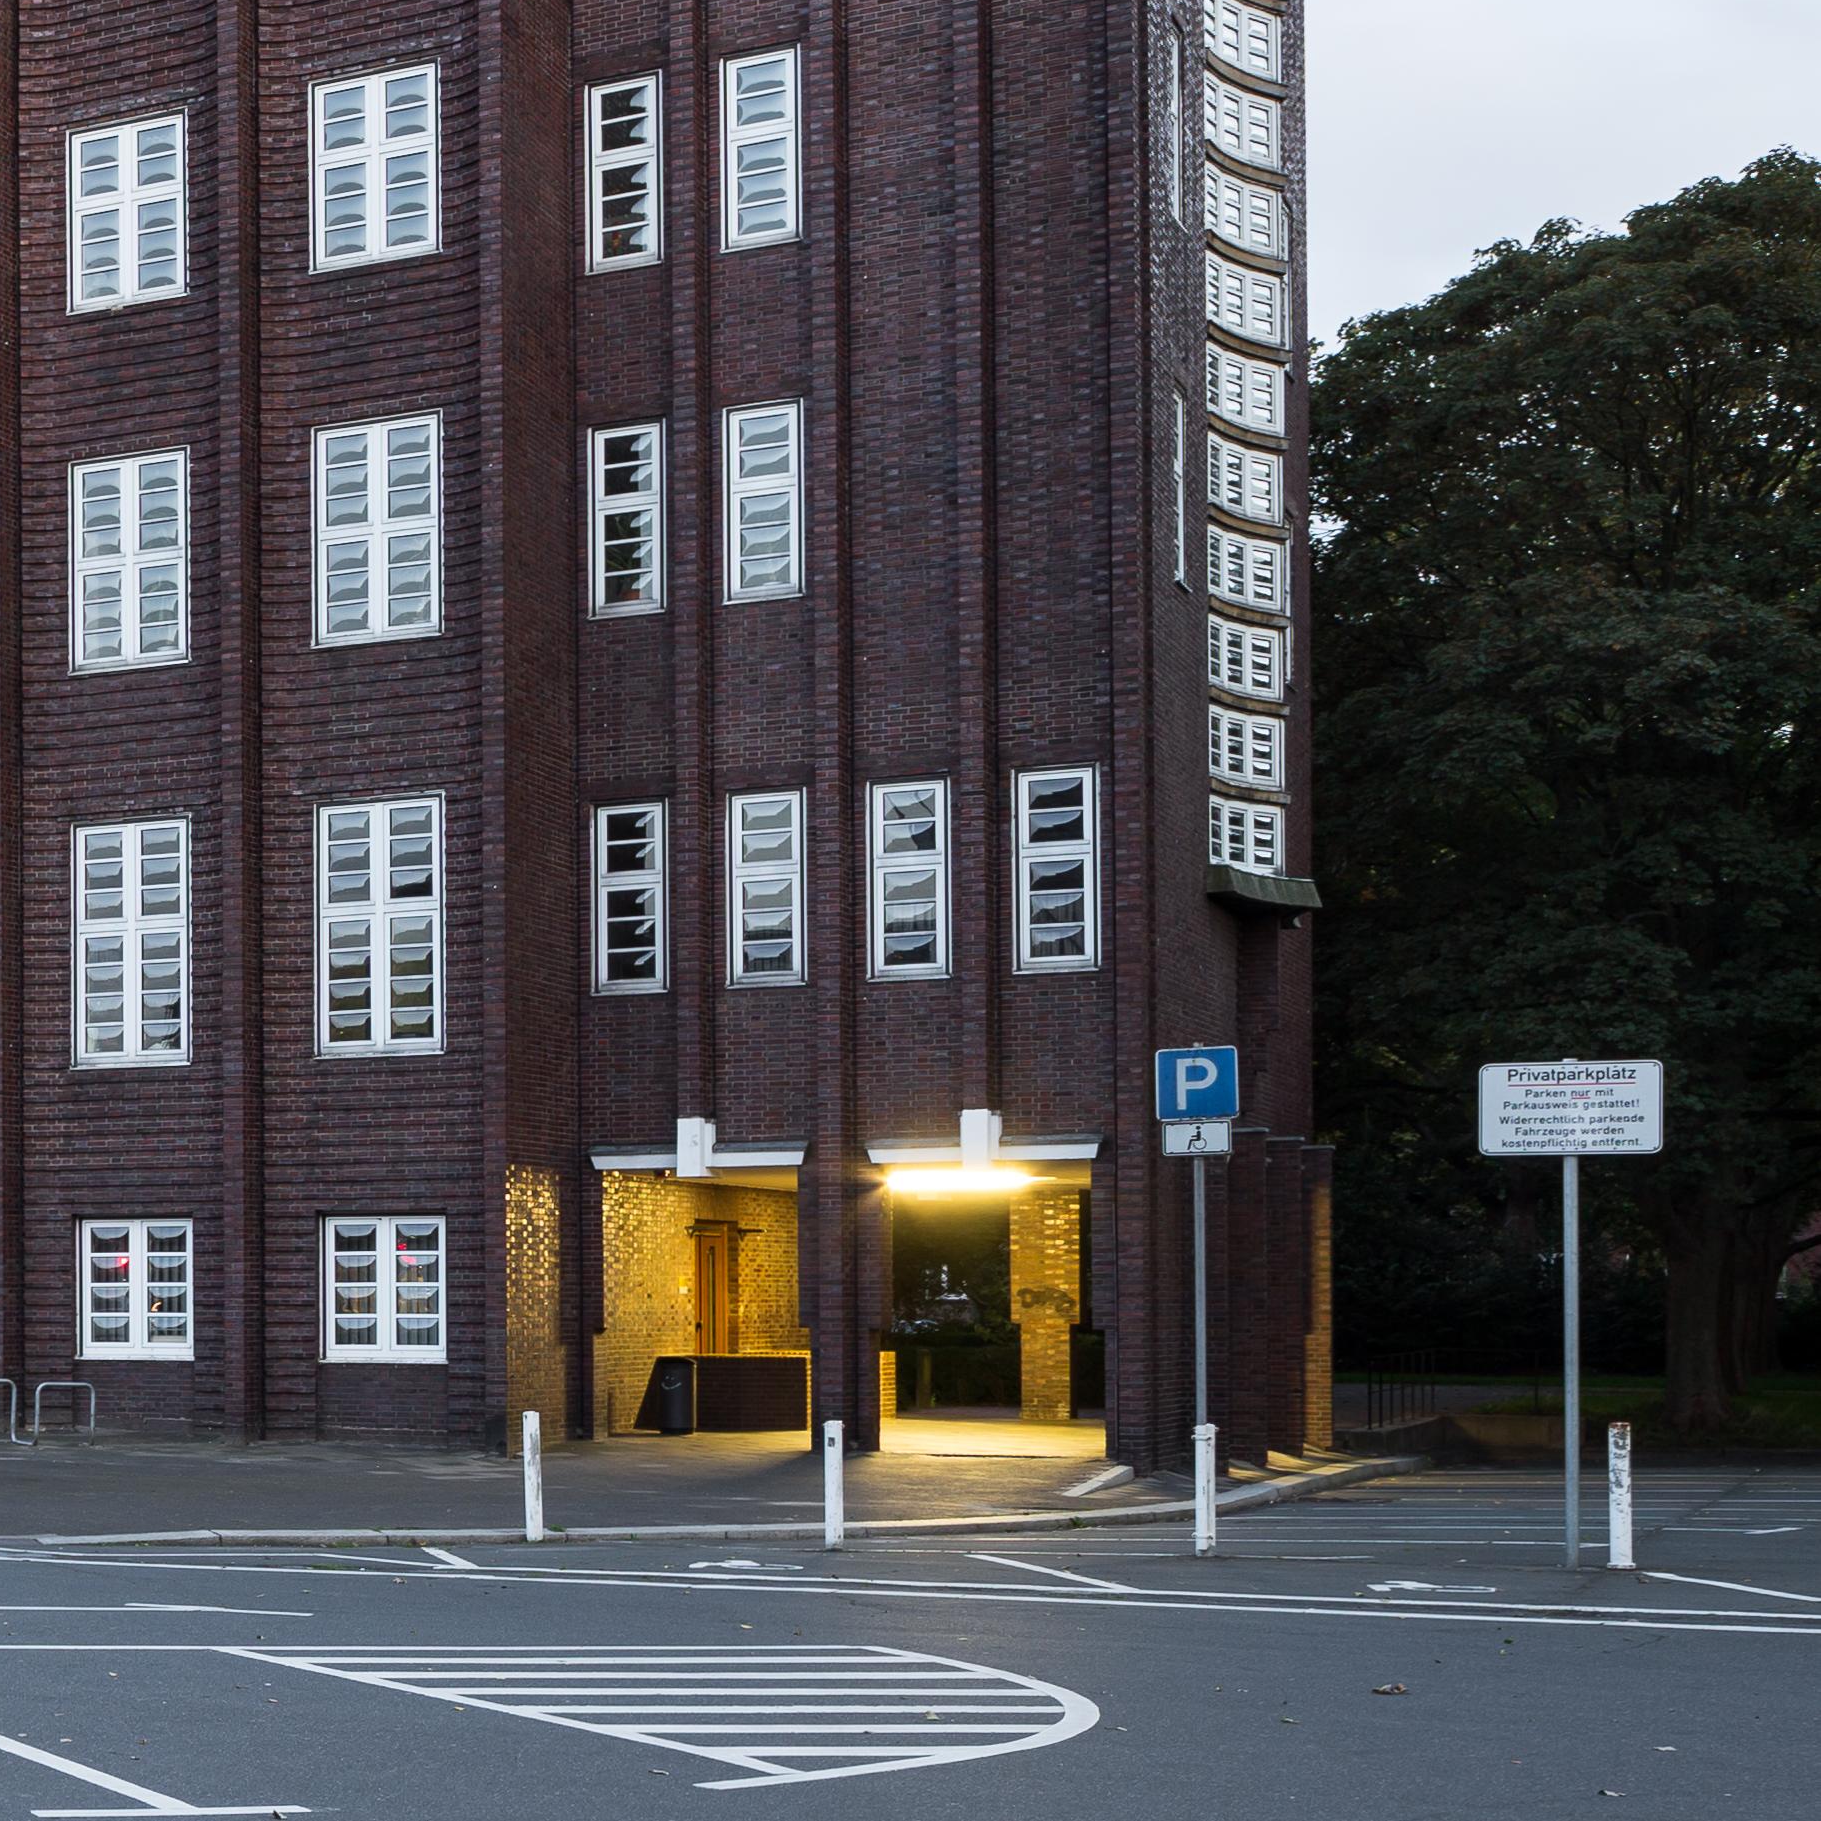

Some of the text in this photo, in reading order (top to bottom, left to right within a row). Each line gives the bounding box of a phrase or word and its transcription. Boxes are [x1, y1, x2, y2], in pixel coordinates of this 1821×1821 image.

[1507, 1067, 1637, 1084] Privatparkplatz
[1176, 1057, 1218, 1110] P
[1525, 1088, 1614, 1098] Parken nur mit
[1503, 1099, 1640, 1110] Parkausweis gestattet!
[1499, 1114, 1645, 1125] Widerrechtlich parkende
[1515, 1126, 1625, 1137] Fahrzeuge werden
[1502, 1138, 1643, 1149] kostenpflichtig entfernt.
